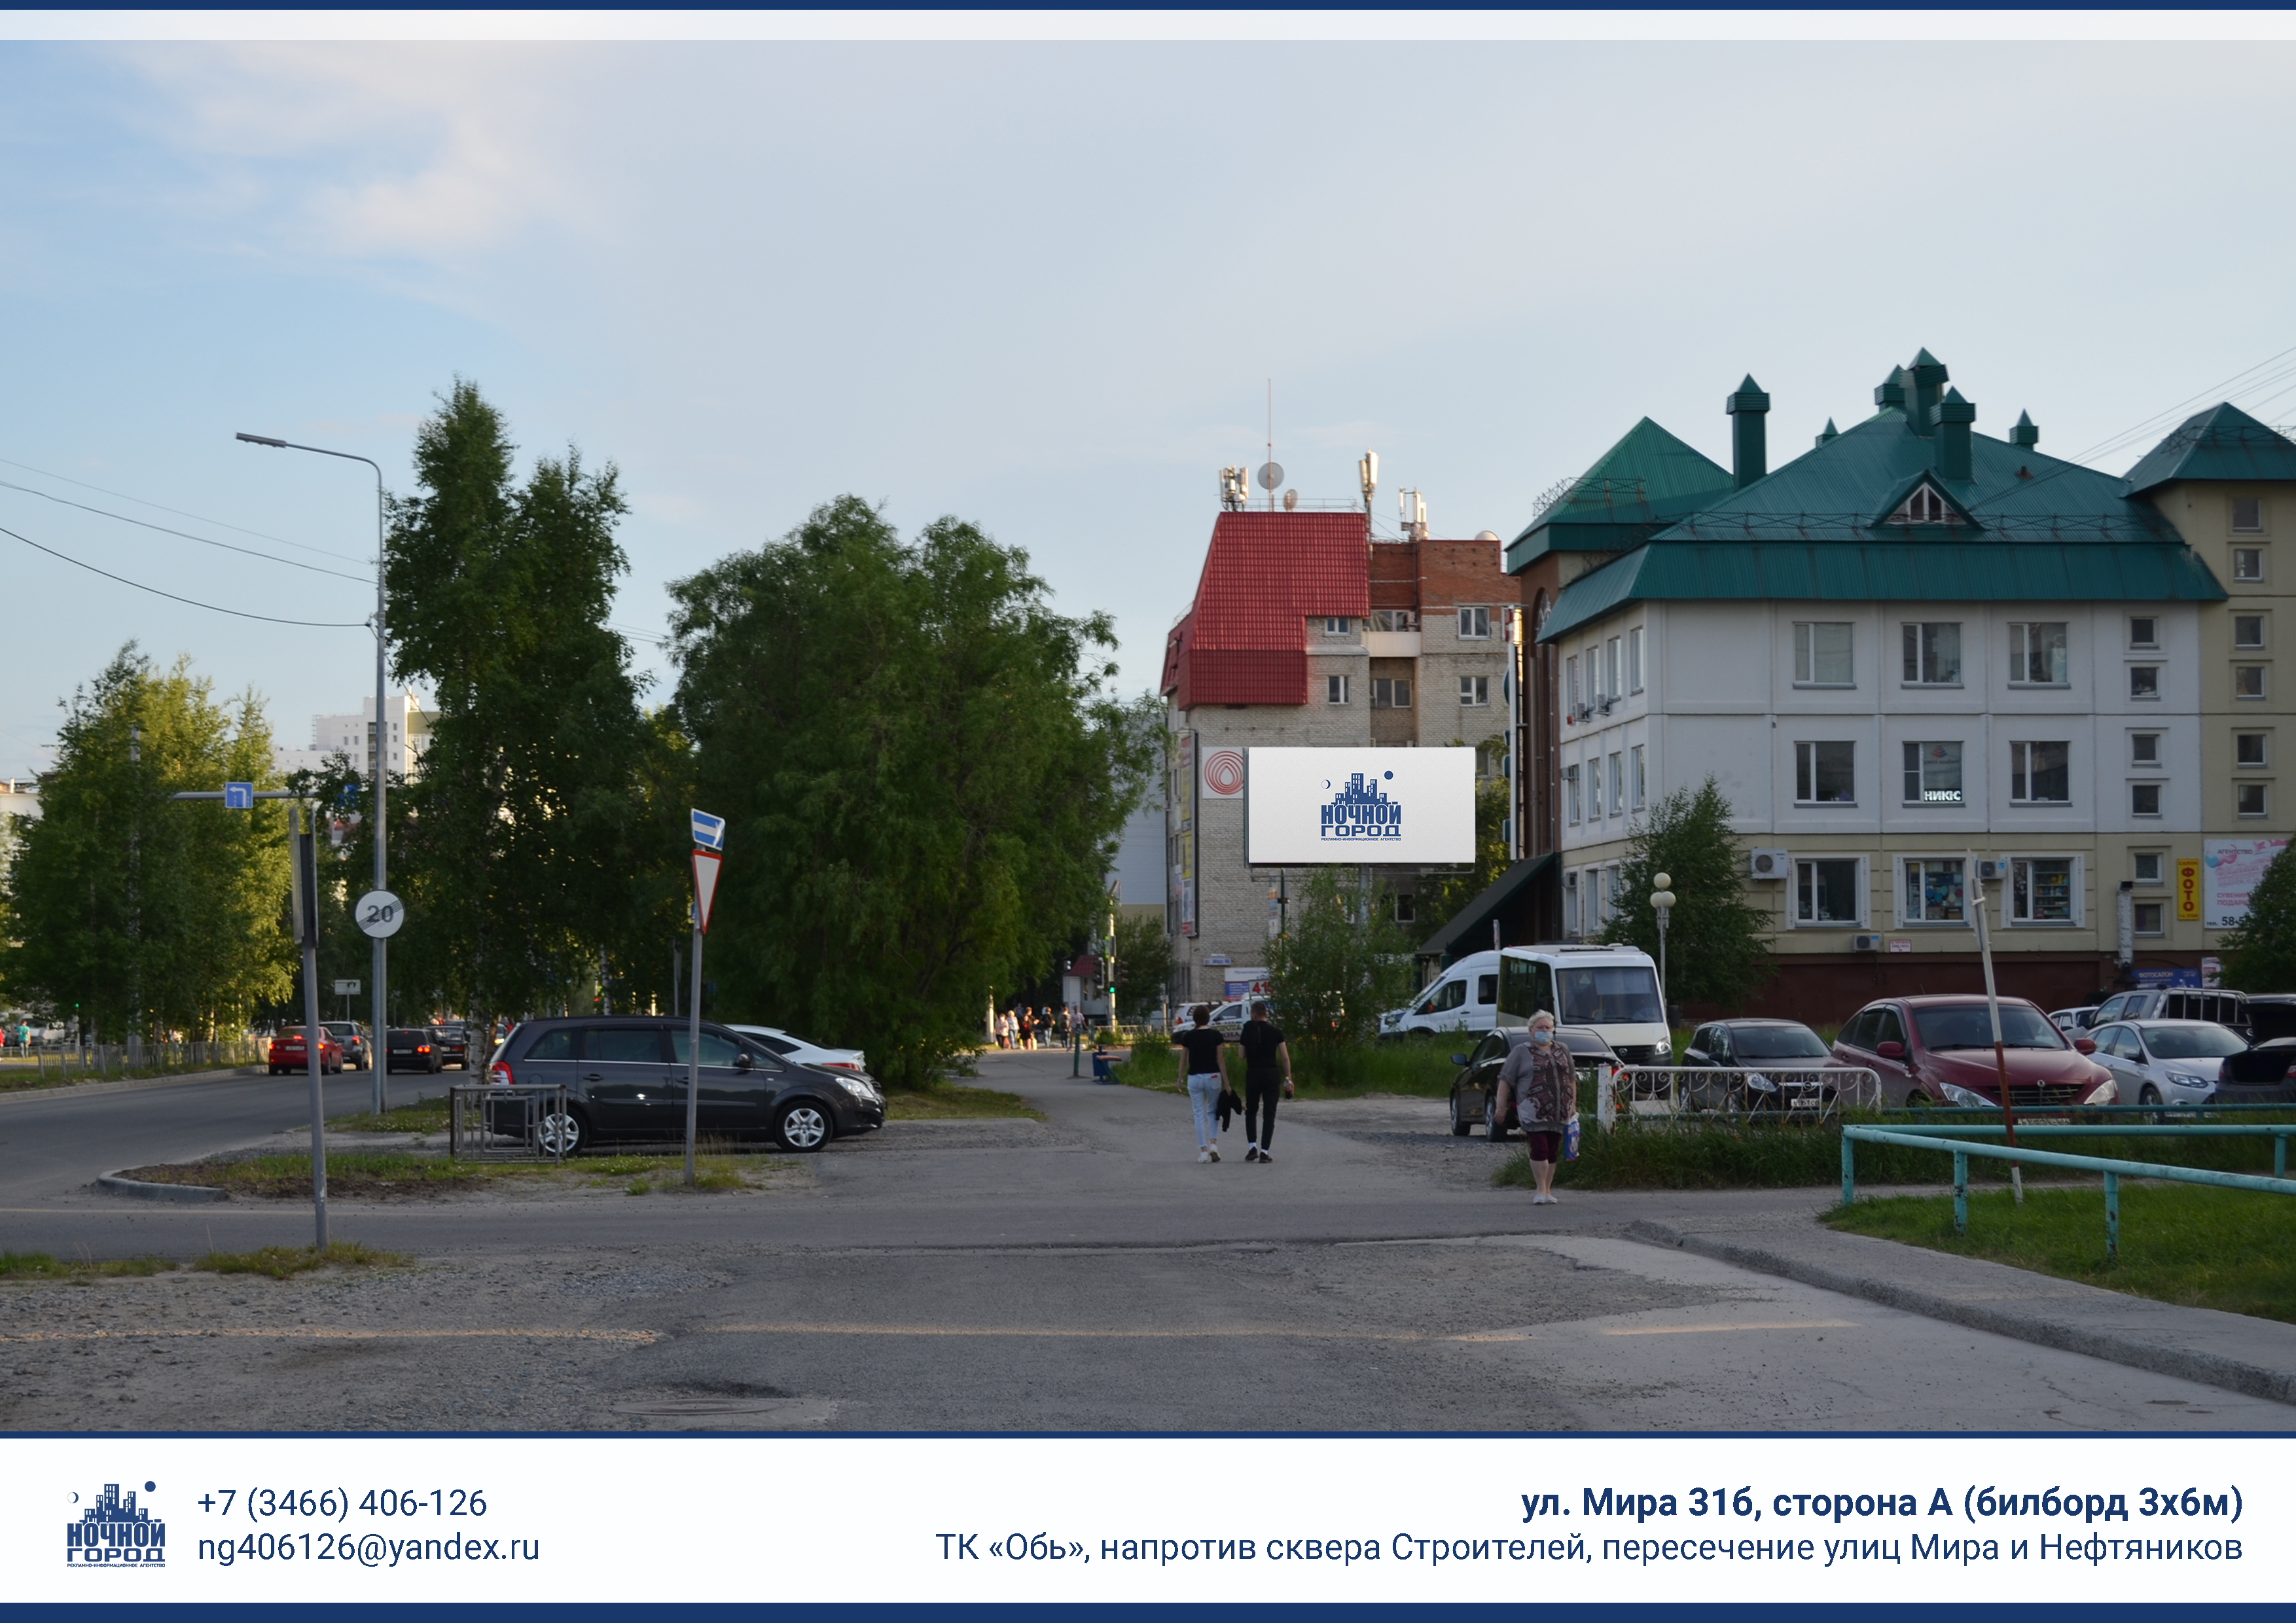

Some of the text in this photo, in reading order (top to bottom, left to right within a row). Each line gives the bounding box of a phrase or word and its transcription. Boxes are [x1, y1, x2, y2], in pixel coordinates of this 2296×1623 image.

[1321, 802, 1401, 825] НОЧНОЙ
[1321, 825, 1401, 836] ГОРОД
[2181, 867, 2195, 912] ФОТО
[367, 905, 393, 923] 20
